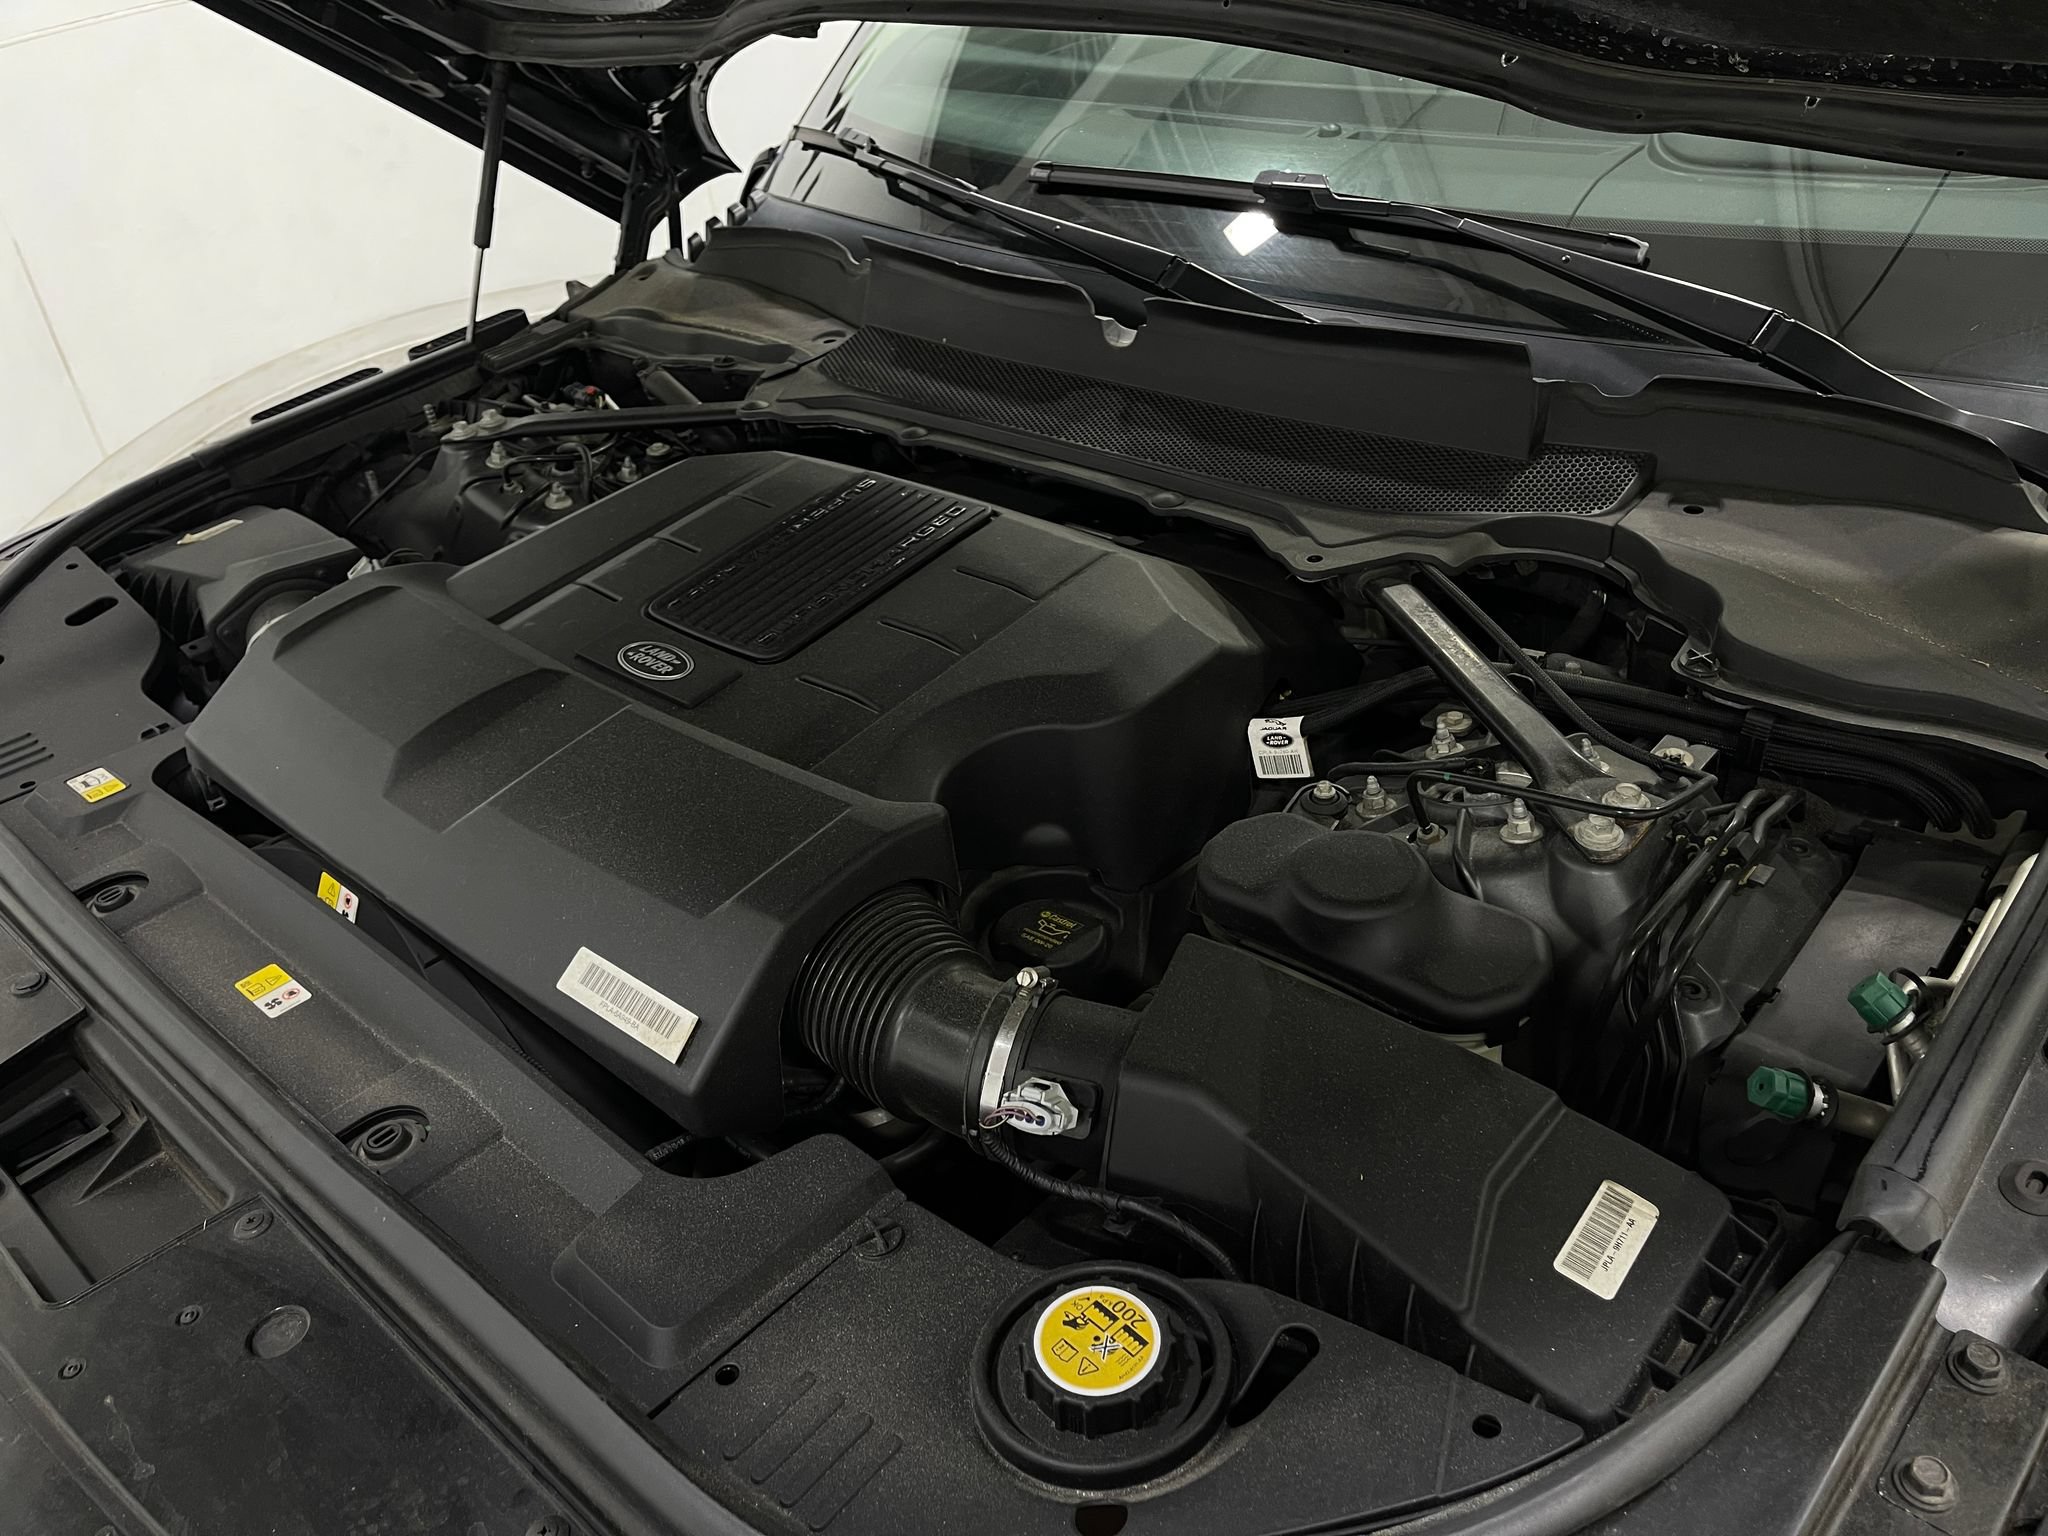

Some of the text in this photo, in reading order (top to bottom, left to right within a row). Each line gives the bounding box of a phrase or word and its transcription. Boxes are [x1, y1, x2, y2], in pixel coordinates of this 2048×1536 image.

[628, 652, 674, 674] ROVER
[639, 645, 676, 662] LAND
[1071, 1300, 1083, 1311] OK
[1112, 1300, 1147, 1330] 200
